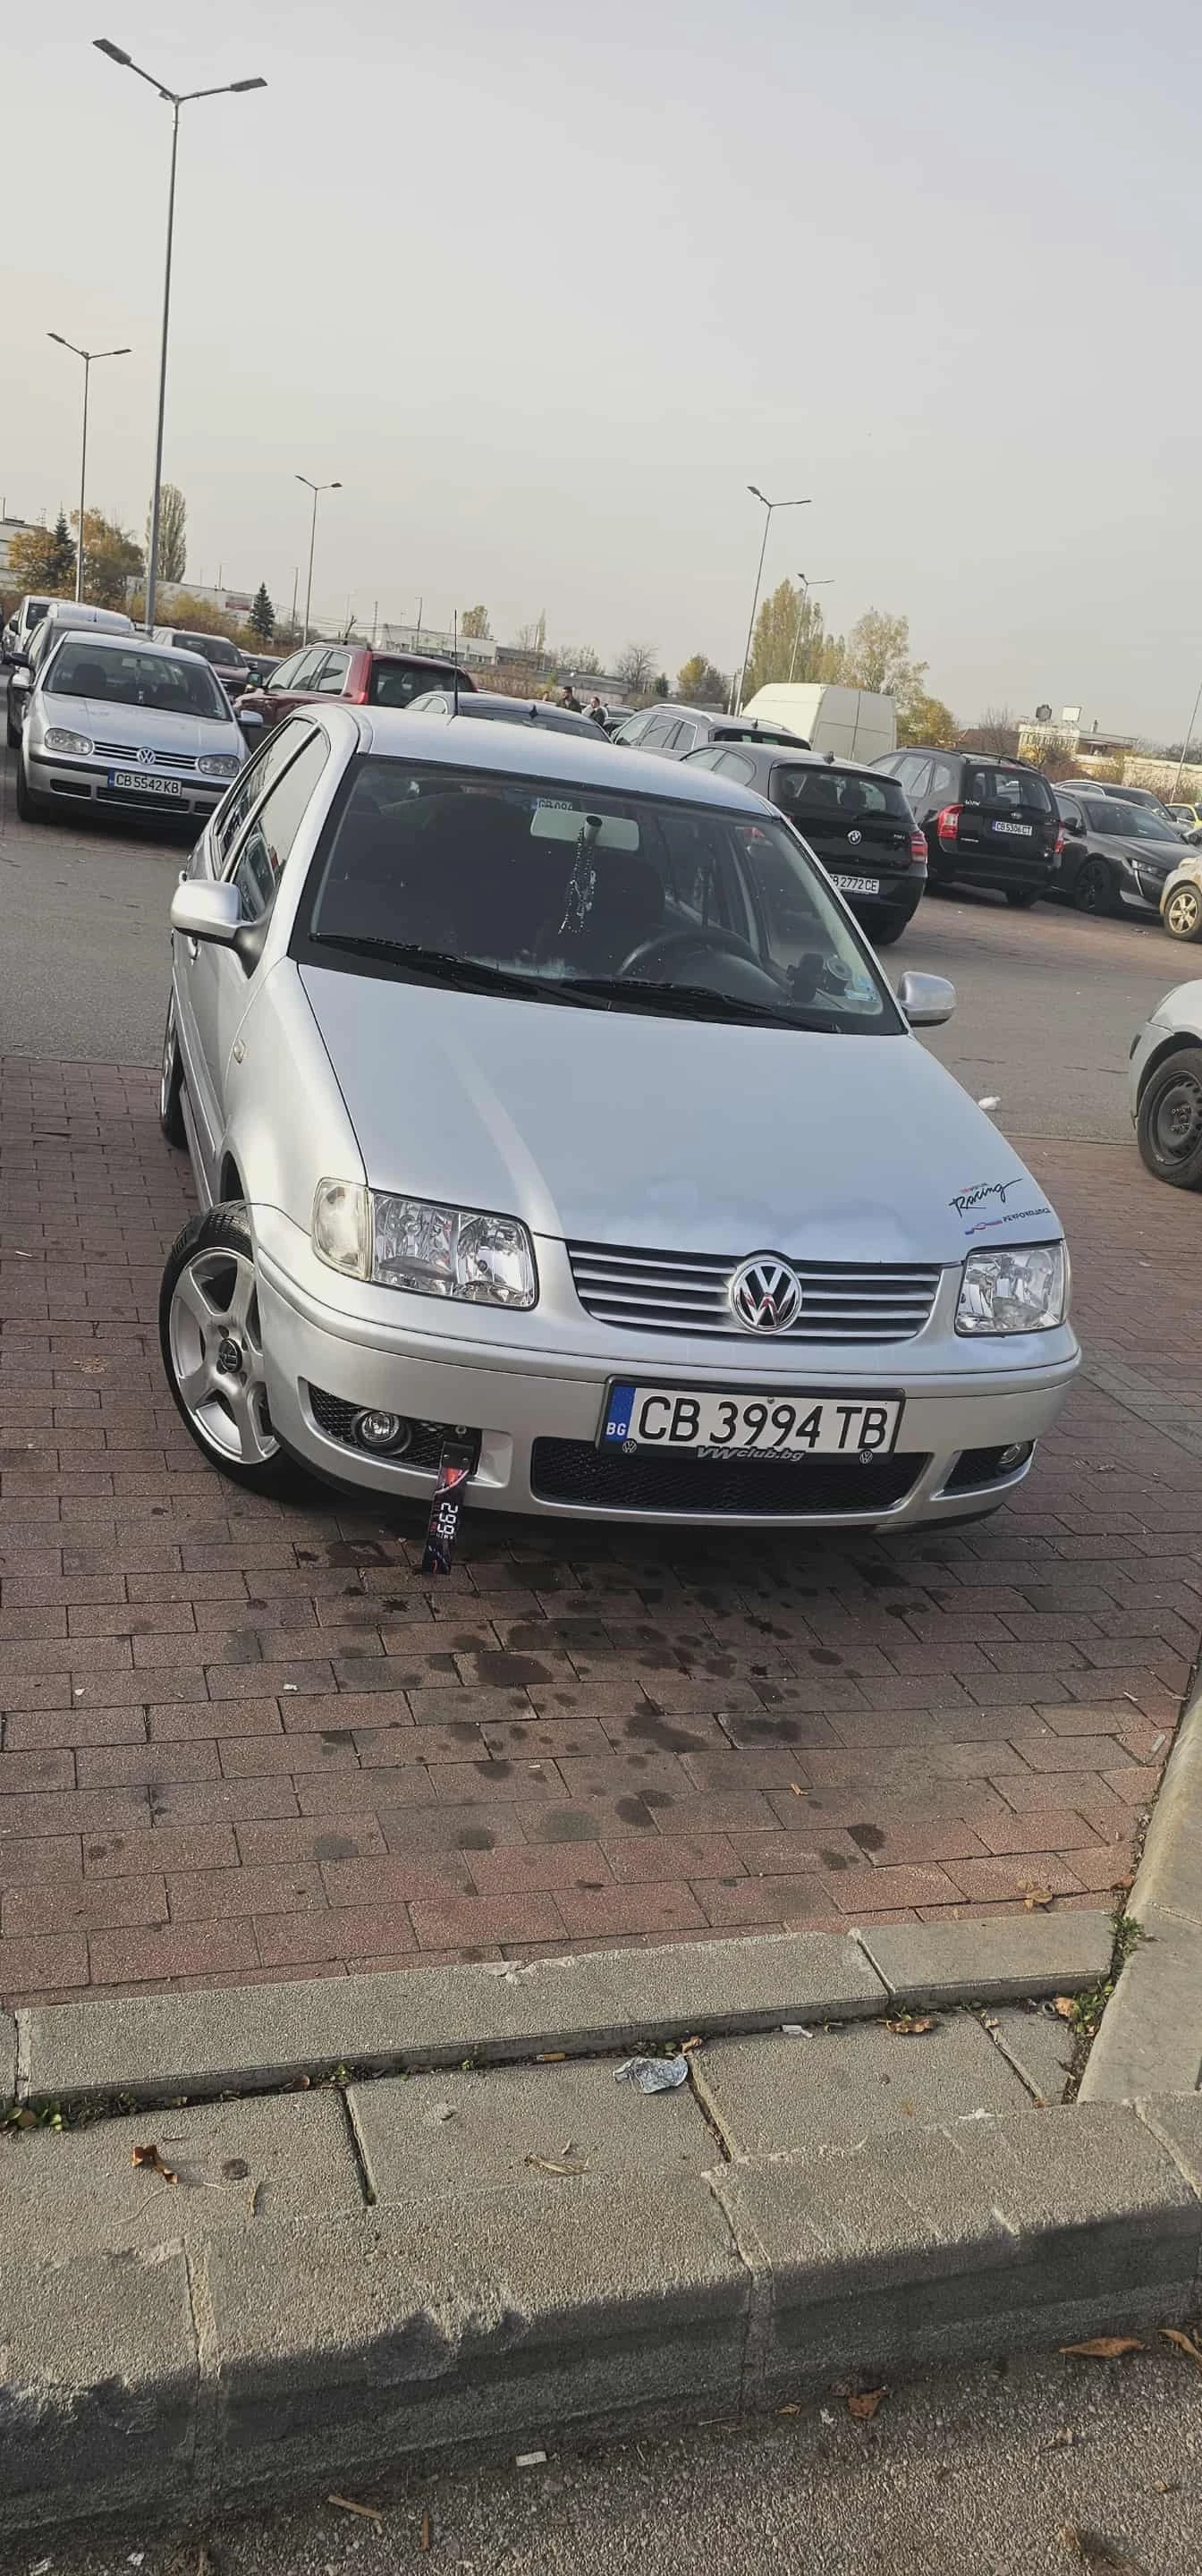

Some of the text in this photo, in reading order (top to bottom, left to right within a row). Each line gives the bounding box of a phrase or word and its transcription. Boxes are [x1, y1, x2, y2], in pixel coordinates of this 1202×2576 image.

[116, 774, 179, 793] CB 5542 KB
[841, 877, 864, 889] 2772
[865, 880, 877, 891] CE
[606, 1422, 626, 1436] BG
[639, 1395, 888, 1449] CB 3994 TB
[697, 1446, 805, 1462] VWclub.bg
